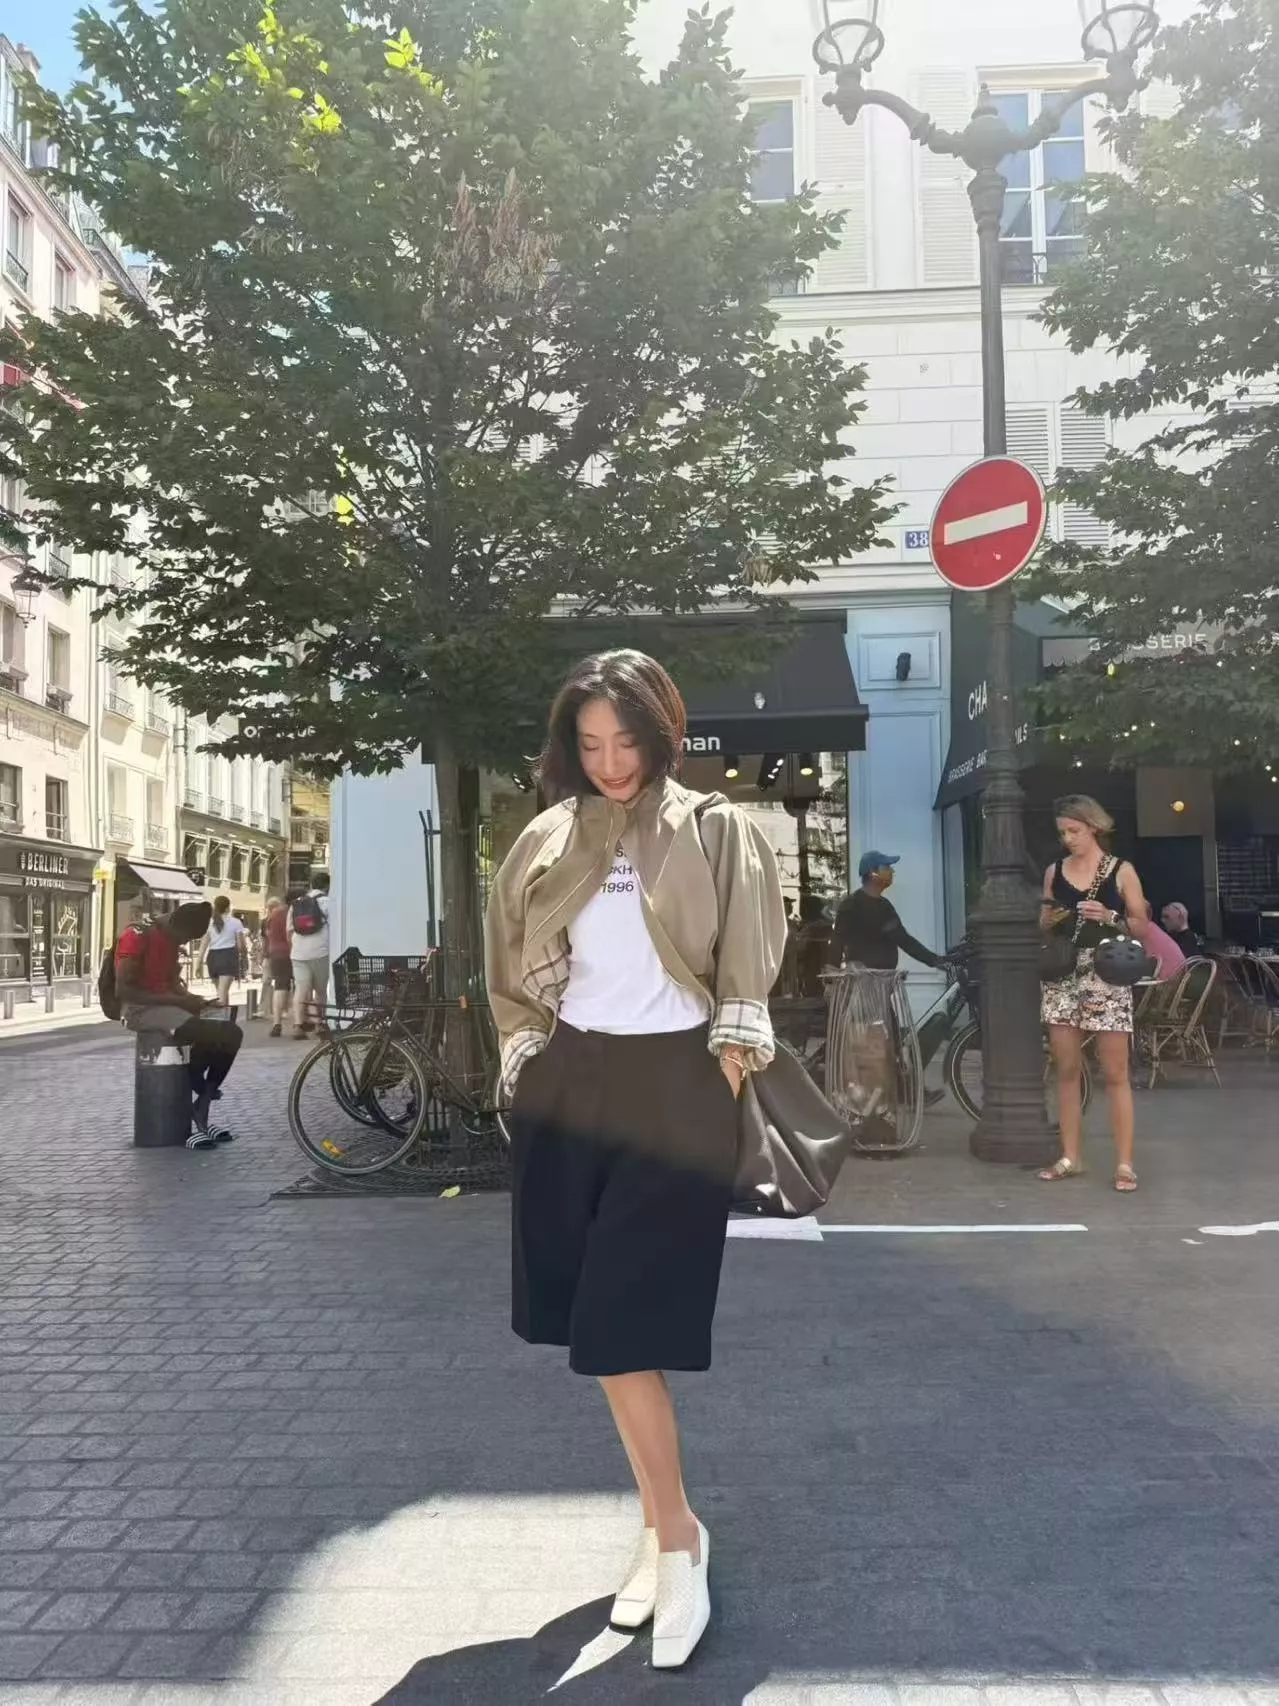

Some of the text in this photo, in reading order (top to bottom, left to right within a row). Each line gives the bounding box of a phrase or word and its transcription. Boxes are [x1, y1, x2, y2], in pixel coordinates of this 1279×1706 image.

[909, 532, 928, 547] 38
[968, 680, 989, 720] CHA
[28, 852, 68, 875] BERLINER
[601, 881, 634, 893] 1996
